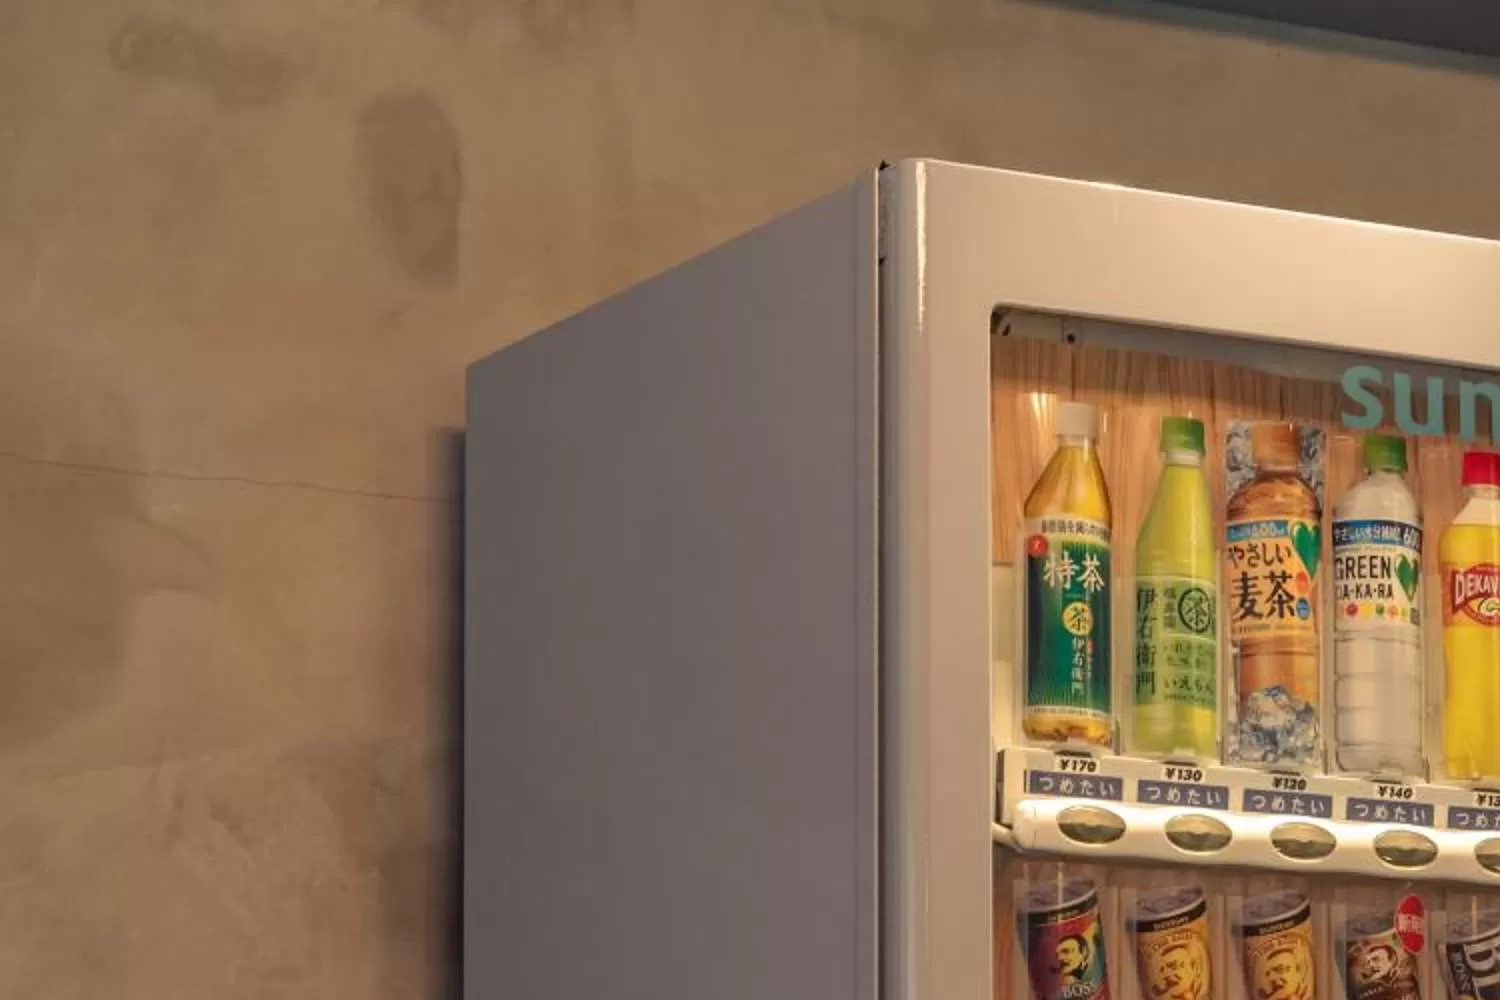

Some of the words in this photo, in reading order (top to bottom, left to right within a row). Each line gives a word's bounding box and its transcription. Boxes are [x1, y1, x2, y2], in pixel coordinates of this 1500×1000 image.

[1228, 542, 1291, 569] やさしい
[1043, 551, 1105, 592] 特茶
[1335, 555, 1391, 579] GREEN
[1232, 571, 1295, 620] 麦茶
[1059, 759, 1097, 772] ¥170
[1165, 767, 1203, 782] ¥130
[1038, 776, 1116, 799] つめたい
[1273, 777, 1308, 791] ¥120
[1378, 785, 1413, 799] ¥140
[1146, 785, 1221, 806] つめたい
[1252, 795, 1326, 815] つめたい
[1354, 804, 1427, 823] つめたい
